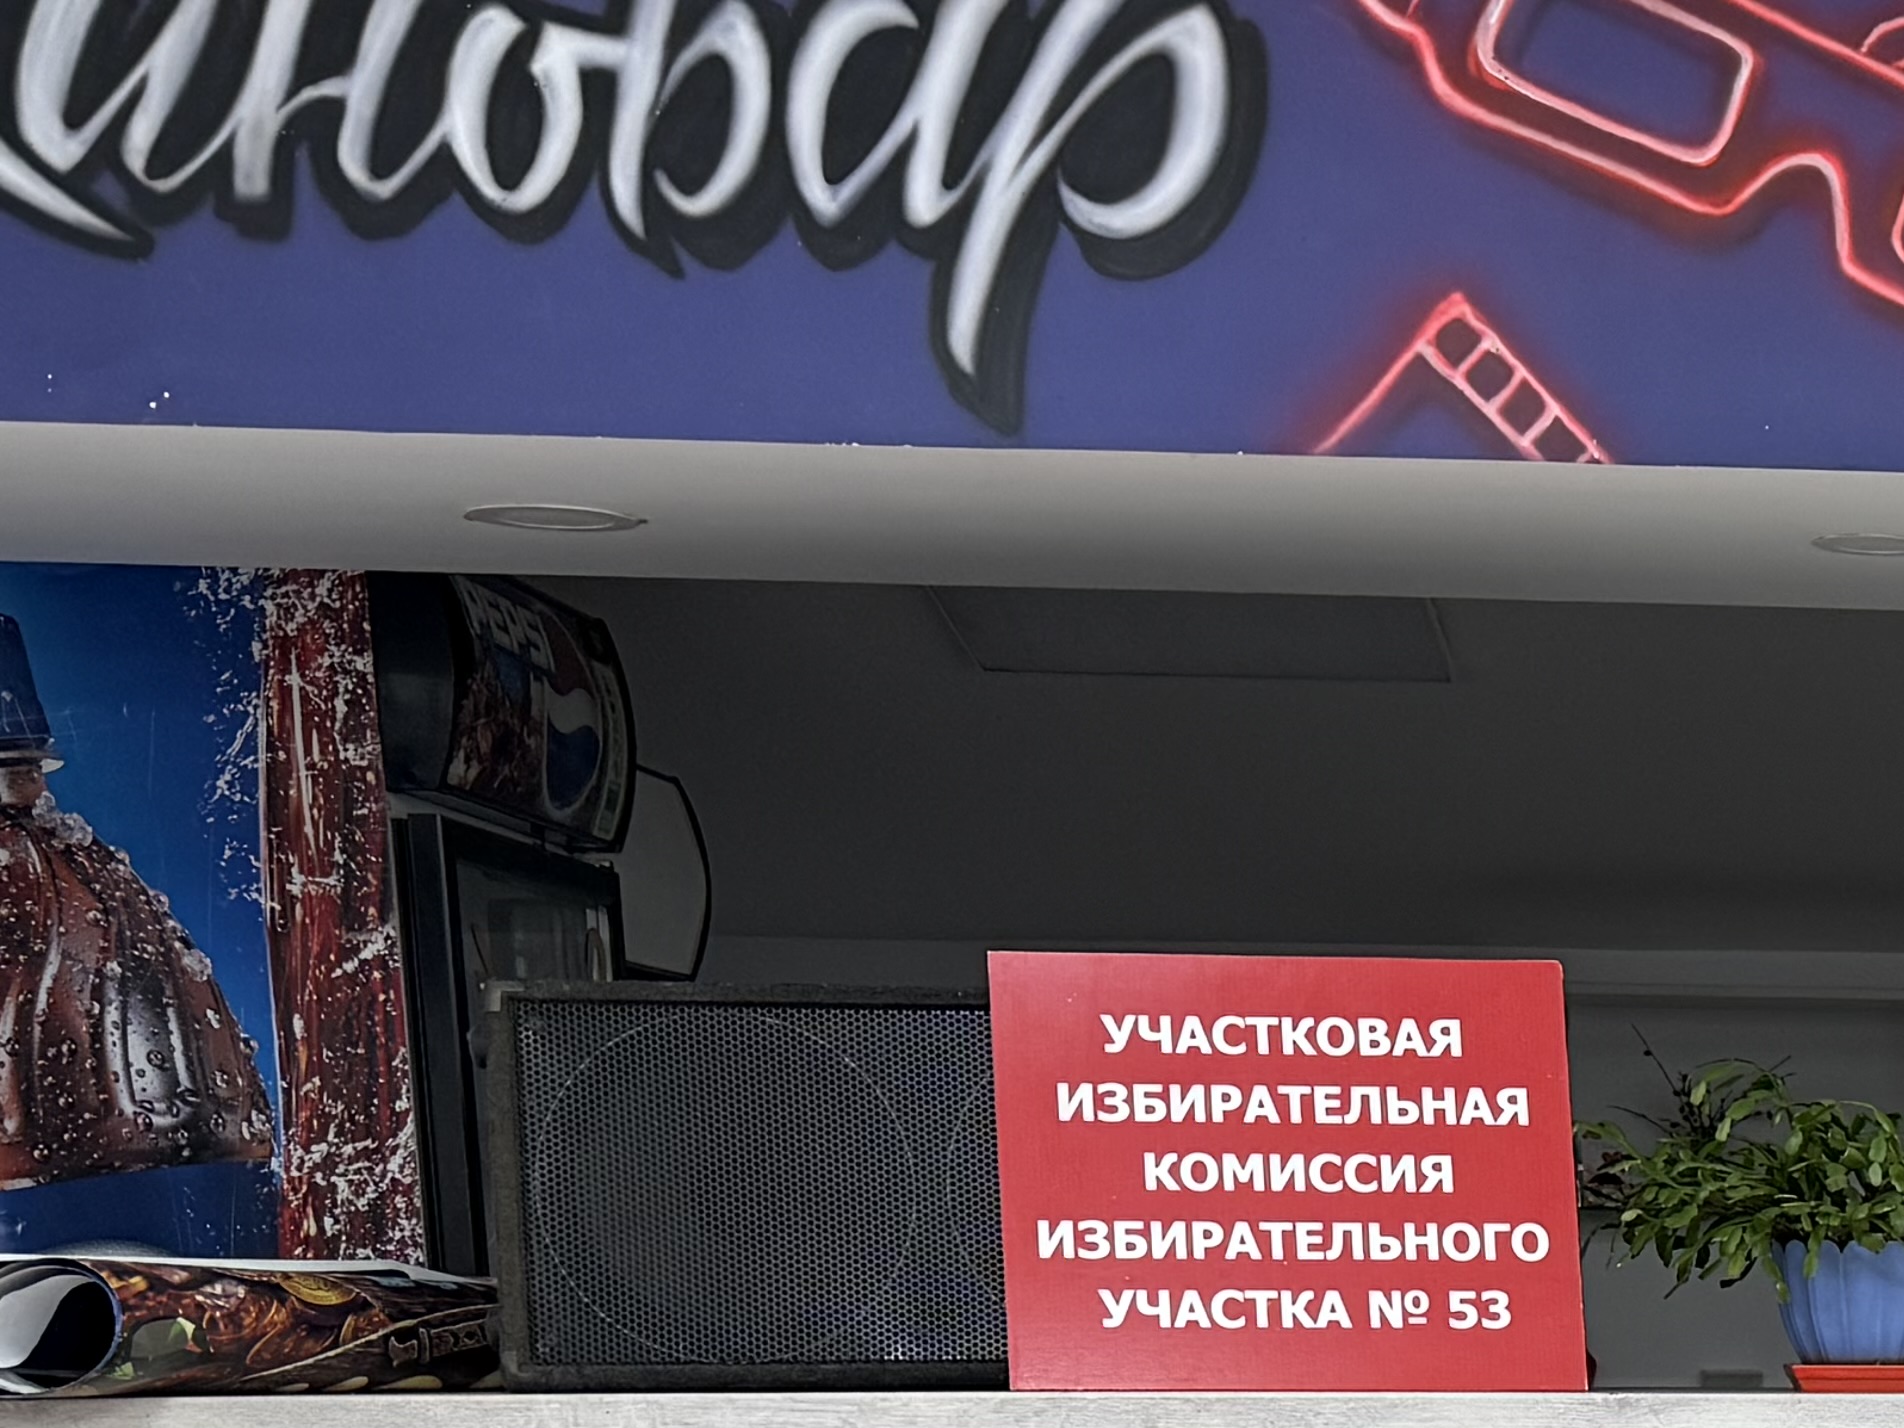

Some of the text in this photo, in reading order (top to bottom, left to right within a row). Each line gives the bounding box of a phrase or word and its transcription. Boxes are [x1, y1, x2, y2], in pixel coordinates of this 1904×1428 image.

[1099, 1014, 1463, 1058] УЧАСТКОВАЯ
[1056, 1082, 1530, 1127] ИЗБИРАТЕЛЬНАЯ
[1143, 1151, 1454, 1194] КОМИССИЯ
[1037, 1219, 1550, 1265] ИЗБИРАТЕЛЬНОГО
[1097, 1288, 1512, 1330] УЧАСТКА № 53
